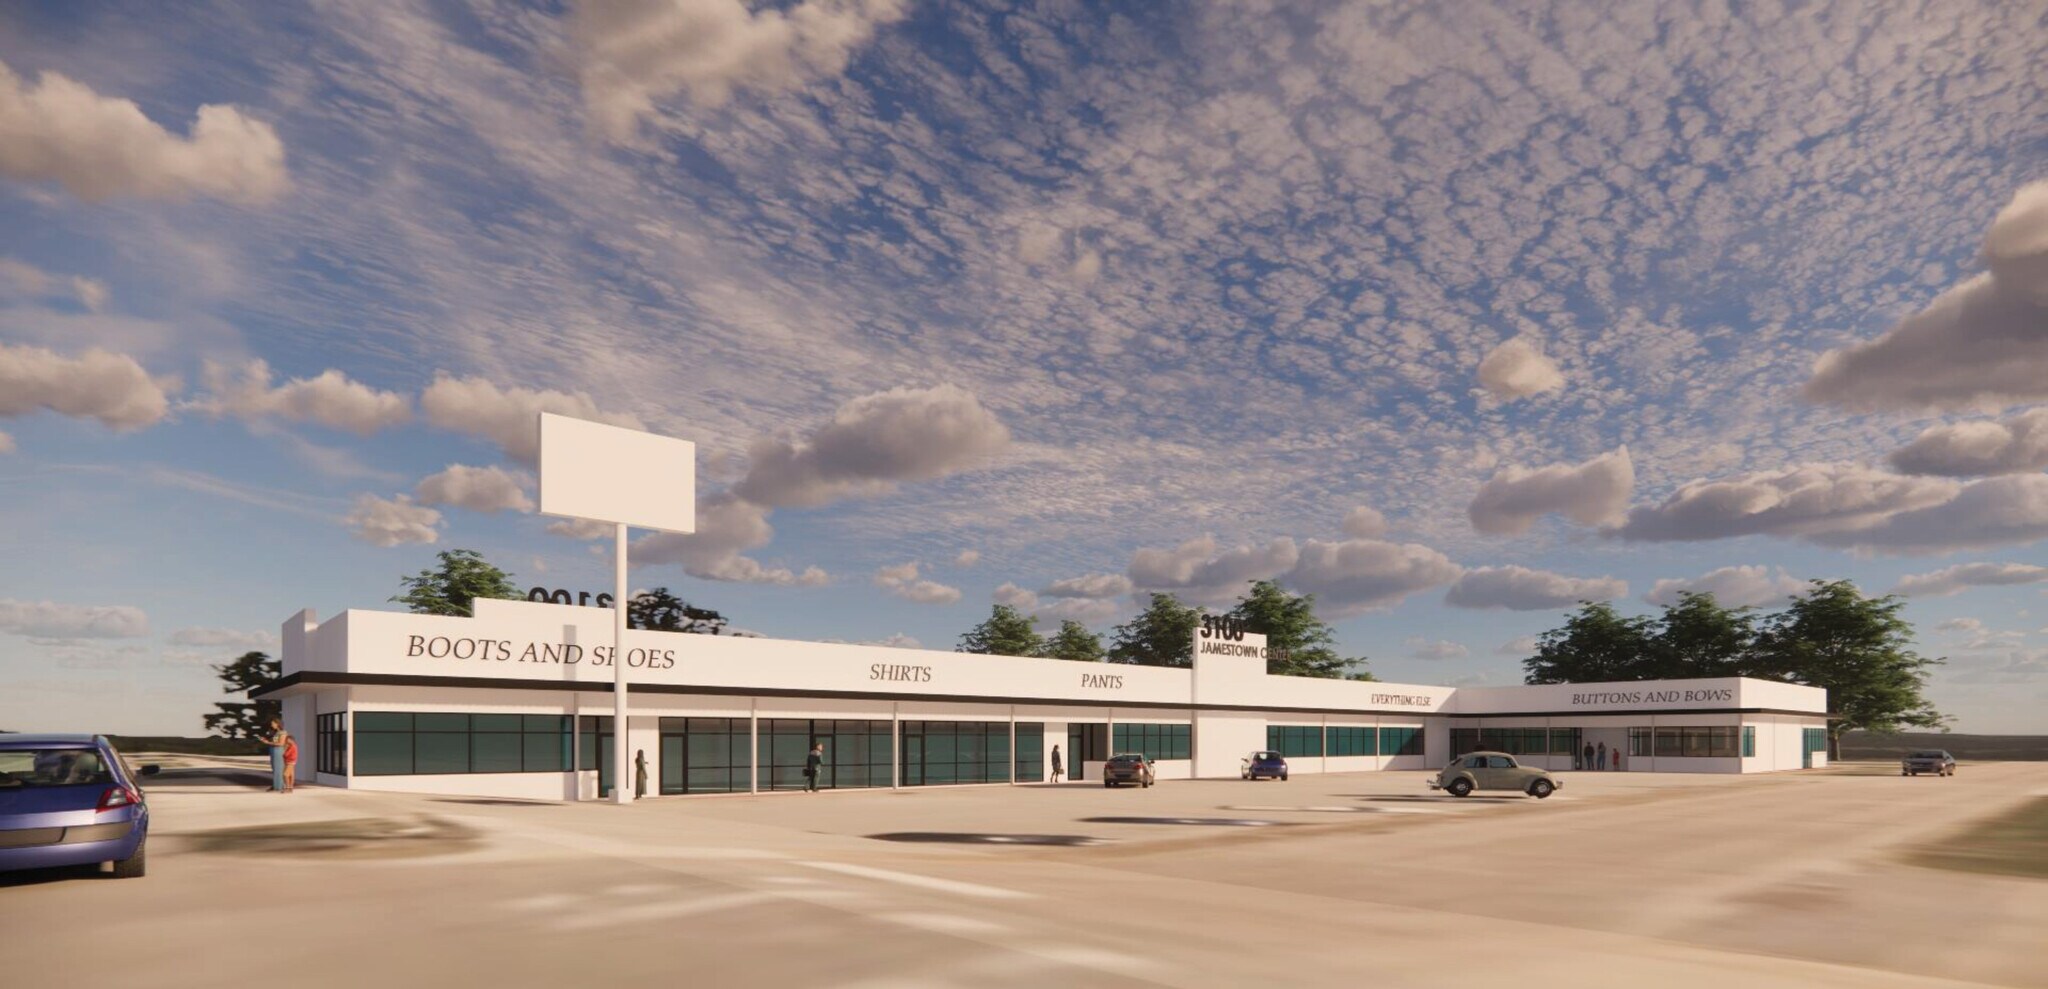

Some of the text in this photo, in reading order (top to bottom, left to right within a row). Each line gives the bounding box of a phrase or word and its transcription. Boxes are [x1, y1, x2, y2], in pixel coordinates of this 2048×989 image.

[1200, 614, 1244, 641] 3100
[407, 635, 511, 661] BOOTS
[518, 642, 583, 664] AND
[1200, 641, 1258, 658] JAMESTOWN
[870, 664, 931, 682] SHIRTS
[1081, 674, 1123, 689] PANTS
[1371, 694, 1431, 706] EVERYTHING ELSE
[1572, 689, 1732, 705] BUTTONS AND BOWS
